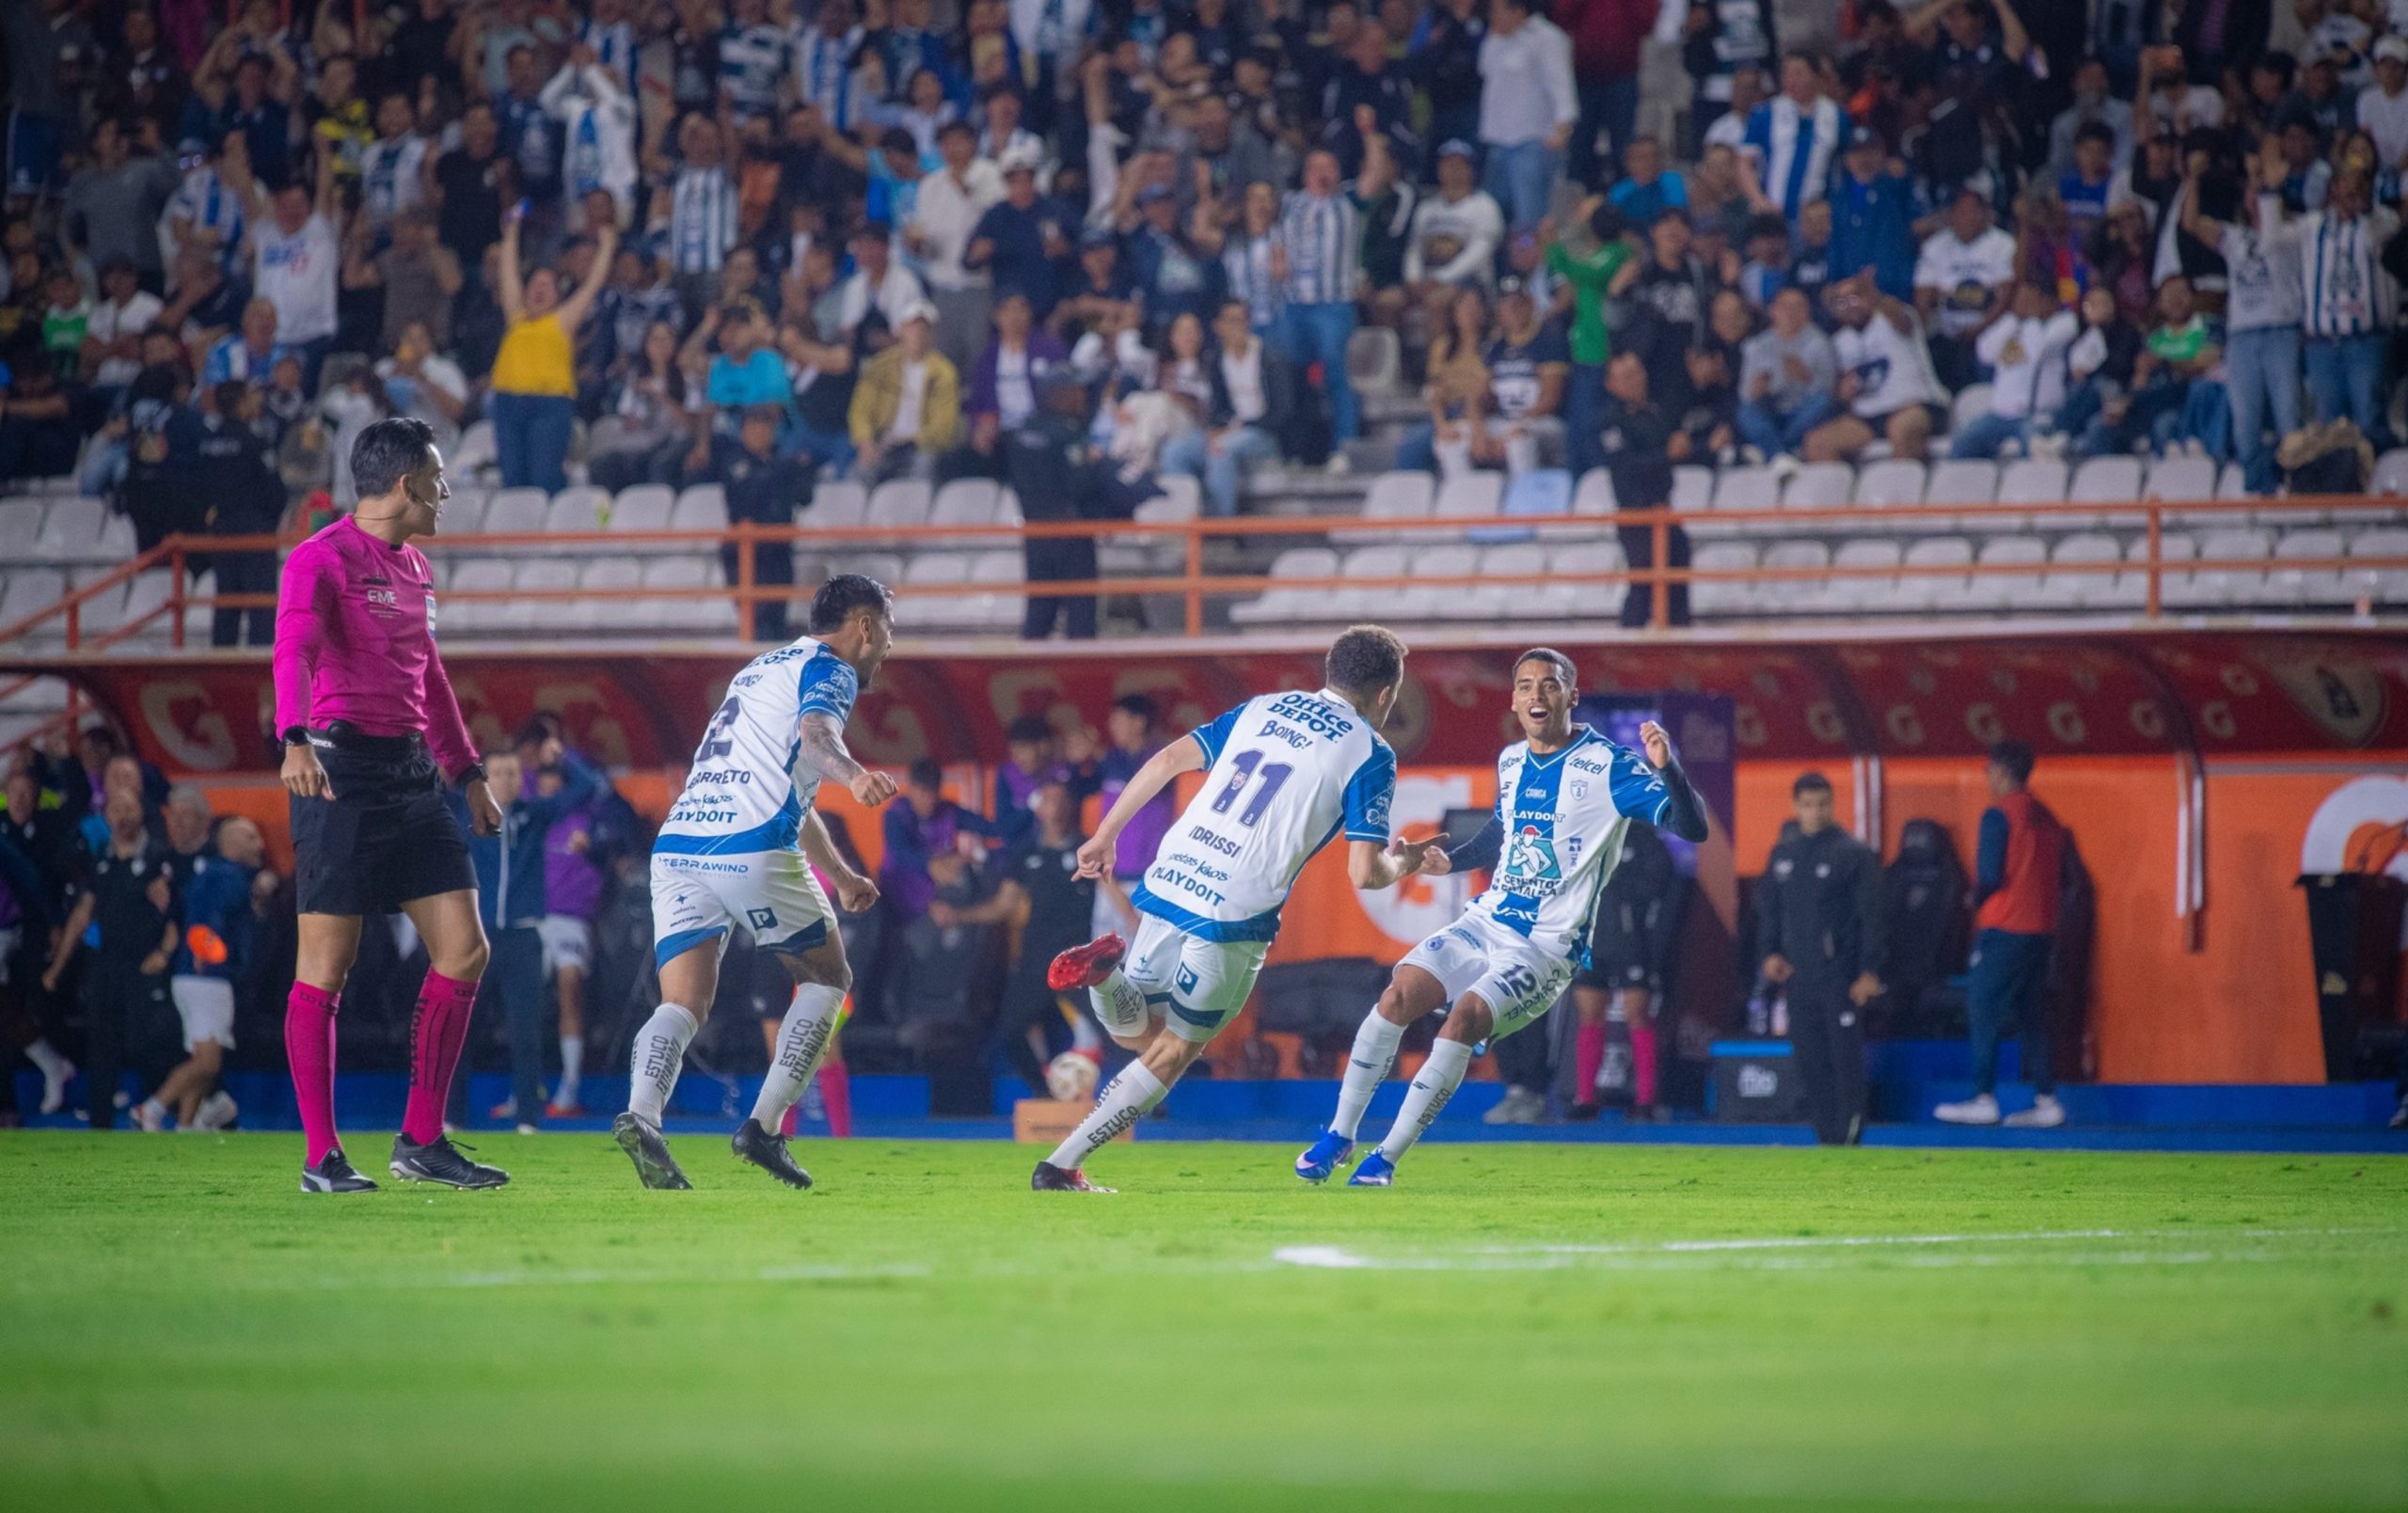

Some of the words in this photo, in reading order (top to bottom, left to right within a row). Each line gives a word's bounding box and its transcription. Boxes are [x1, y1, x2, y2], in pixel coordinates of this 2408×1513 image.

[696, 696, 741, 762] 2
[1267, 702, 1343, 741] DEPOT
[1281, 694, 1354, 733] Office
[1569, 758, 1608, 776] telcel
[1212, 749, 1293, 828] 11
[1189, 825, 1242, 858] IDRISSI
[662, 858, 750, 874] TERRAWIND
[1501, 964, 1537, 1000] 12
[644, 1035, 669, 1079] ESTUCO
[779, 1018, 814, 1068] ESTUCO
[788, 1017, 832, 1083] EXTERBLOCK
[1087, 1105, 1138, 1143] ESTUCO
[1418, 1087, 1450, 1125] ESTUCO
